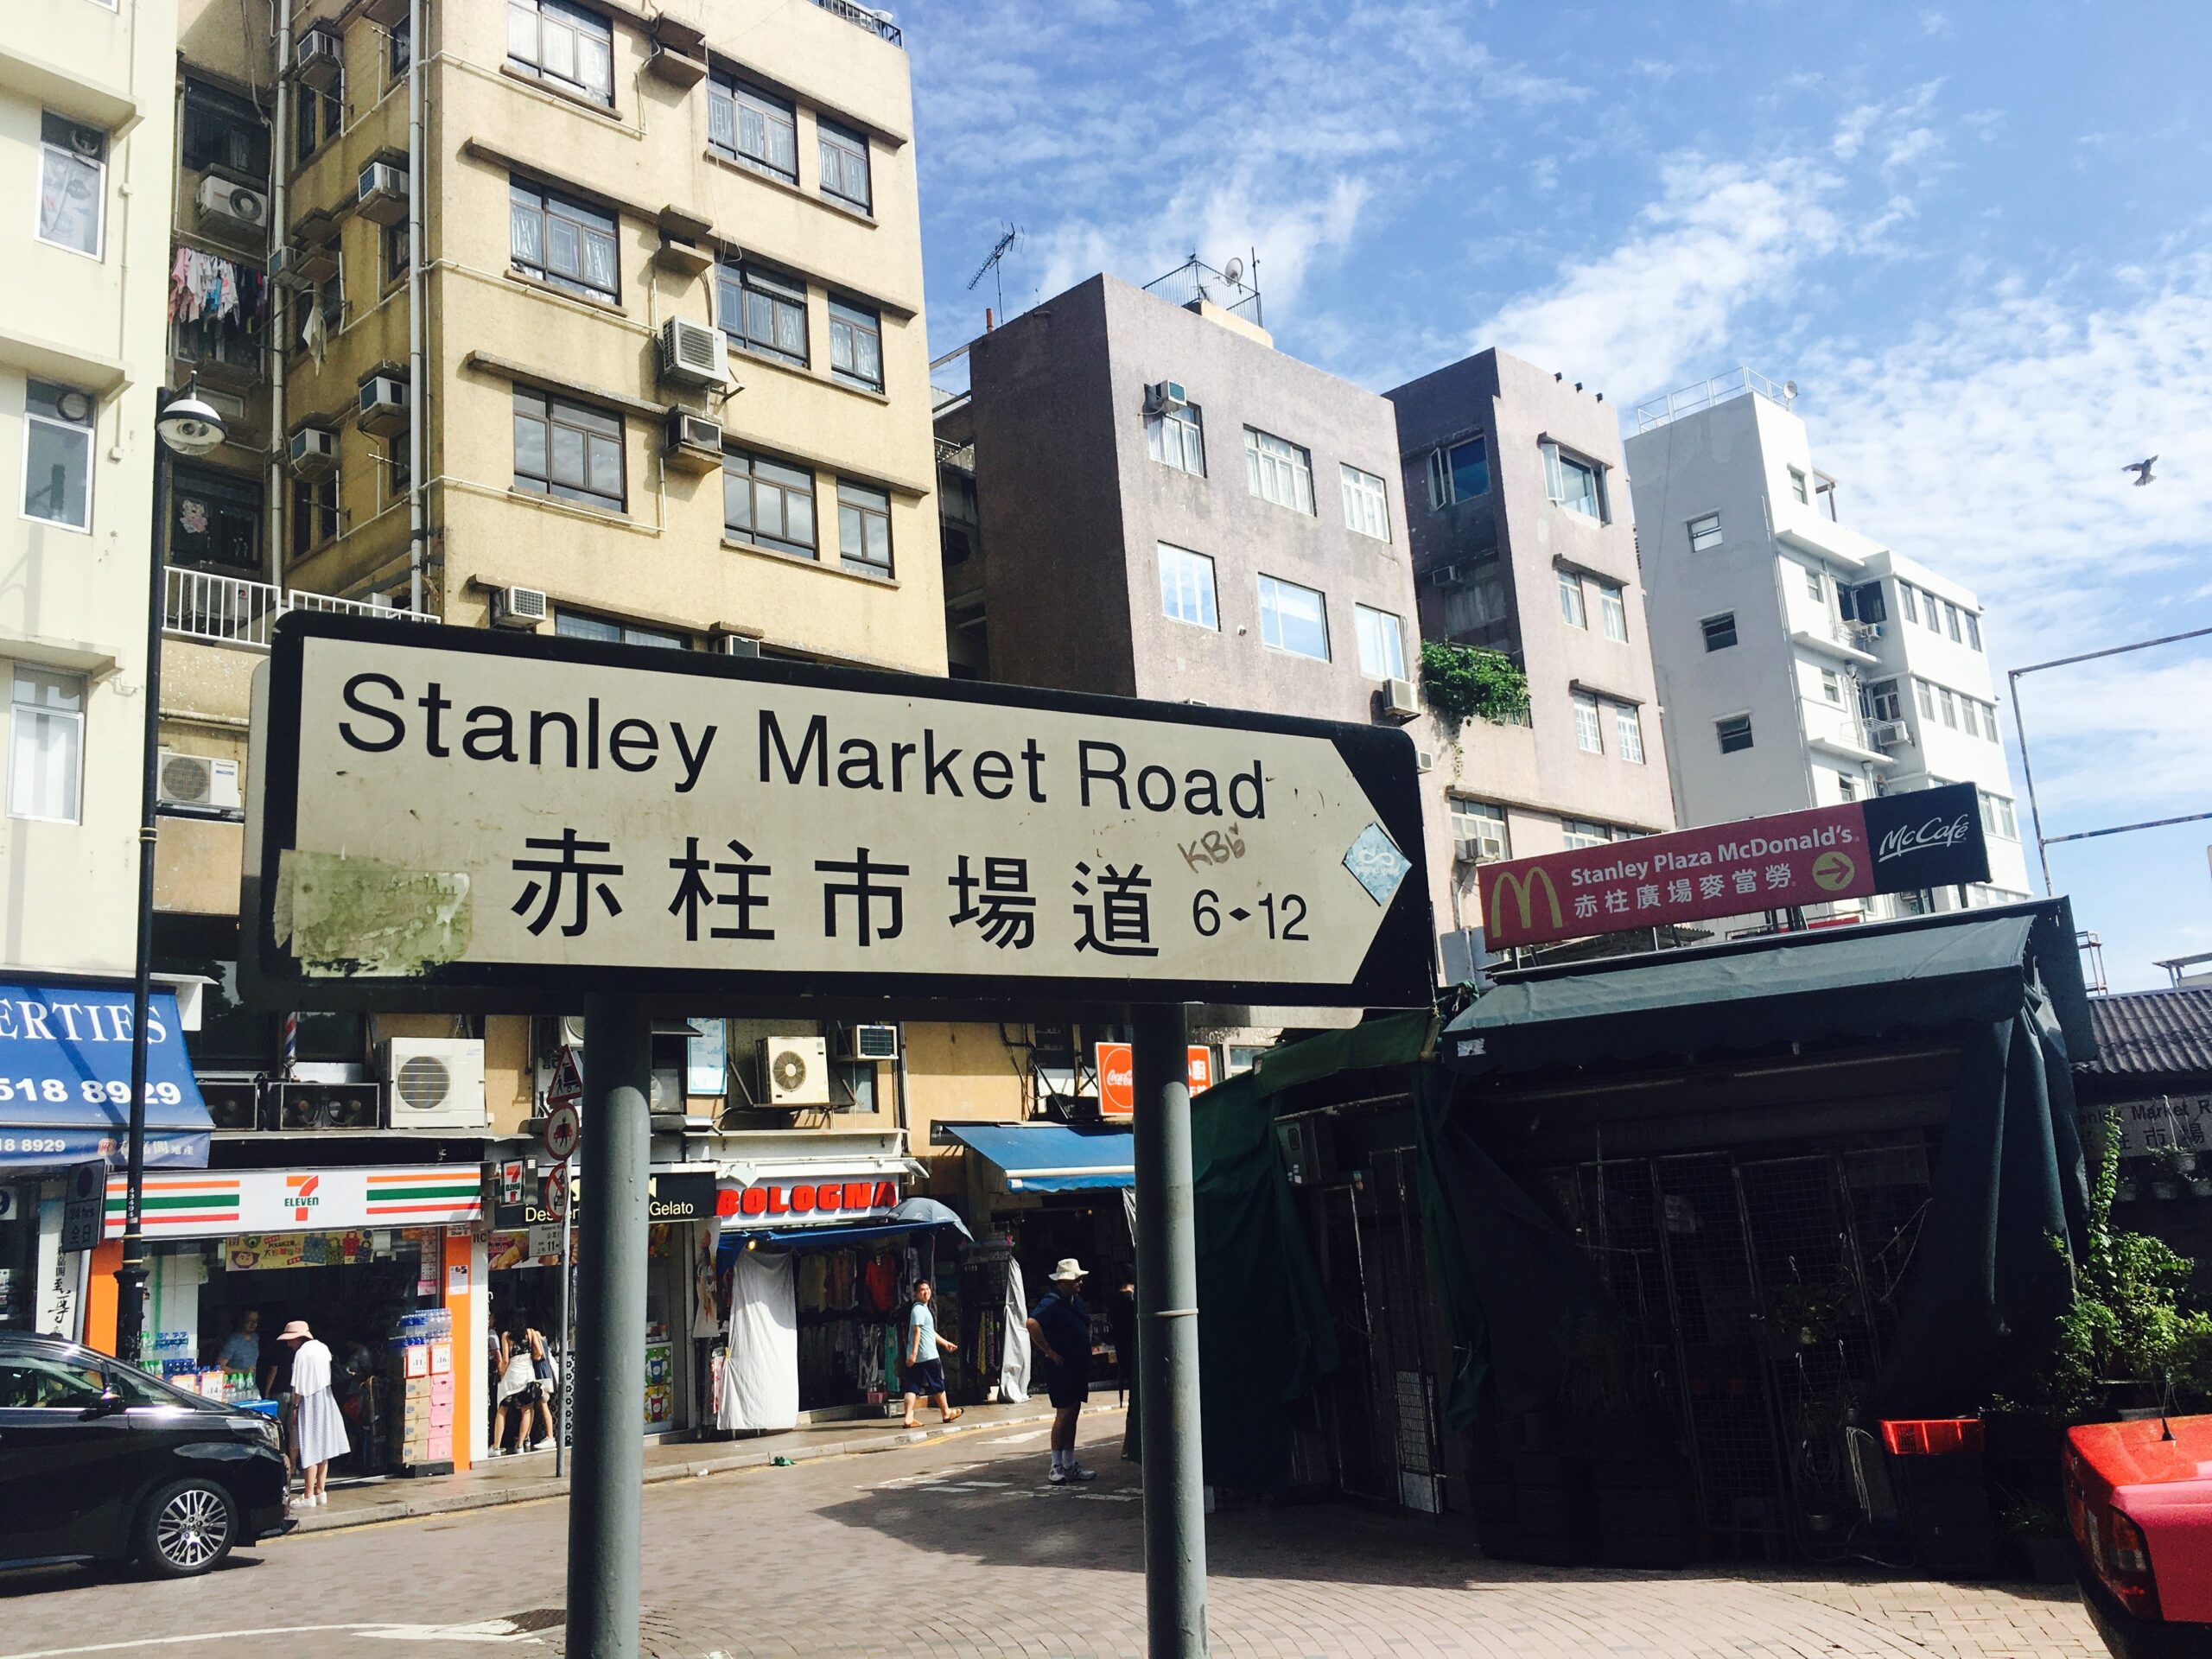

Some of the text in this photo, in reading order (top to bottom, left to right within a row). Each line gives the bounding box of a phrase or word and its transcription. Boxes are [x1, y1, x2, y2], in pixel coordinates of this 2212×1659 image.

[339, 672, 1265, 820] Stanley Market Road
[1570, 824, 1854, 887] Stanley Plaza McDonald's
[1878, 814, 1970, 862] McCafé
[512, 828, 1160, 957] 赤柱市場道
[1573, 862, 1792, 919] 赤柱廣場麥當勞
[22, 1139, 66, 1152] 8929
[649, 1201, 694, 1217] Gelato
[715, 1181, 897, 1217] BOLOGNA
